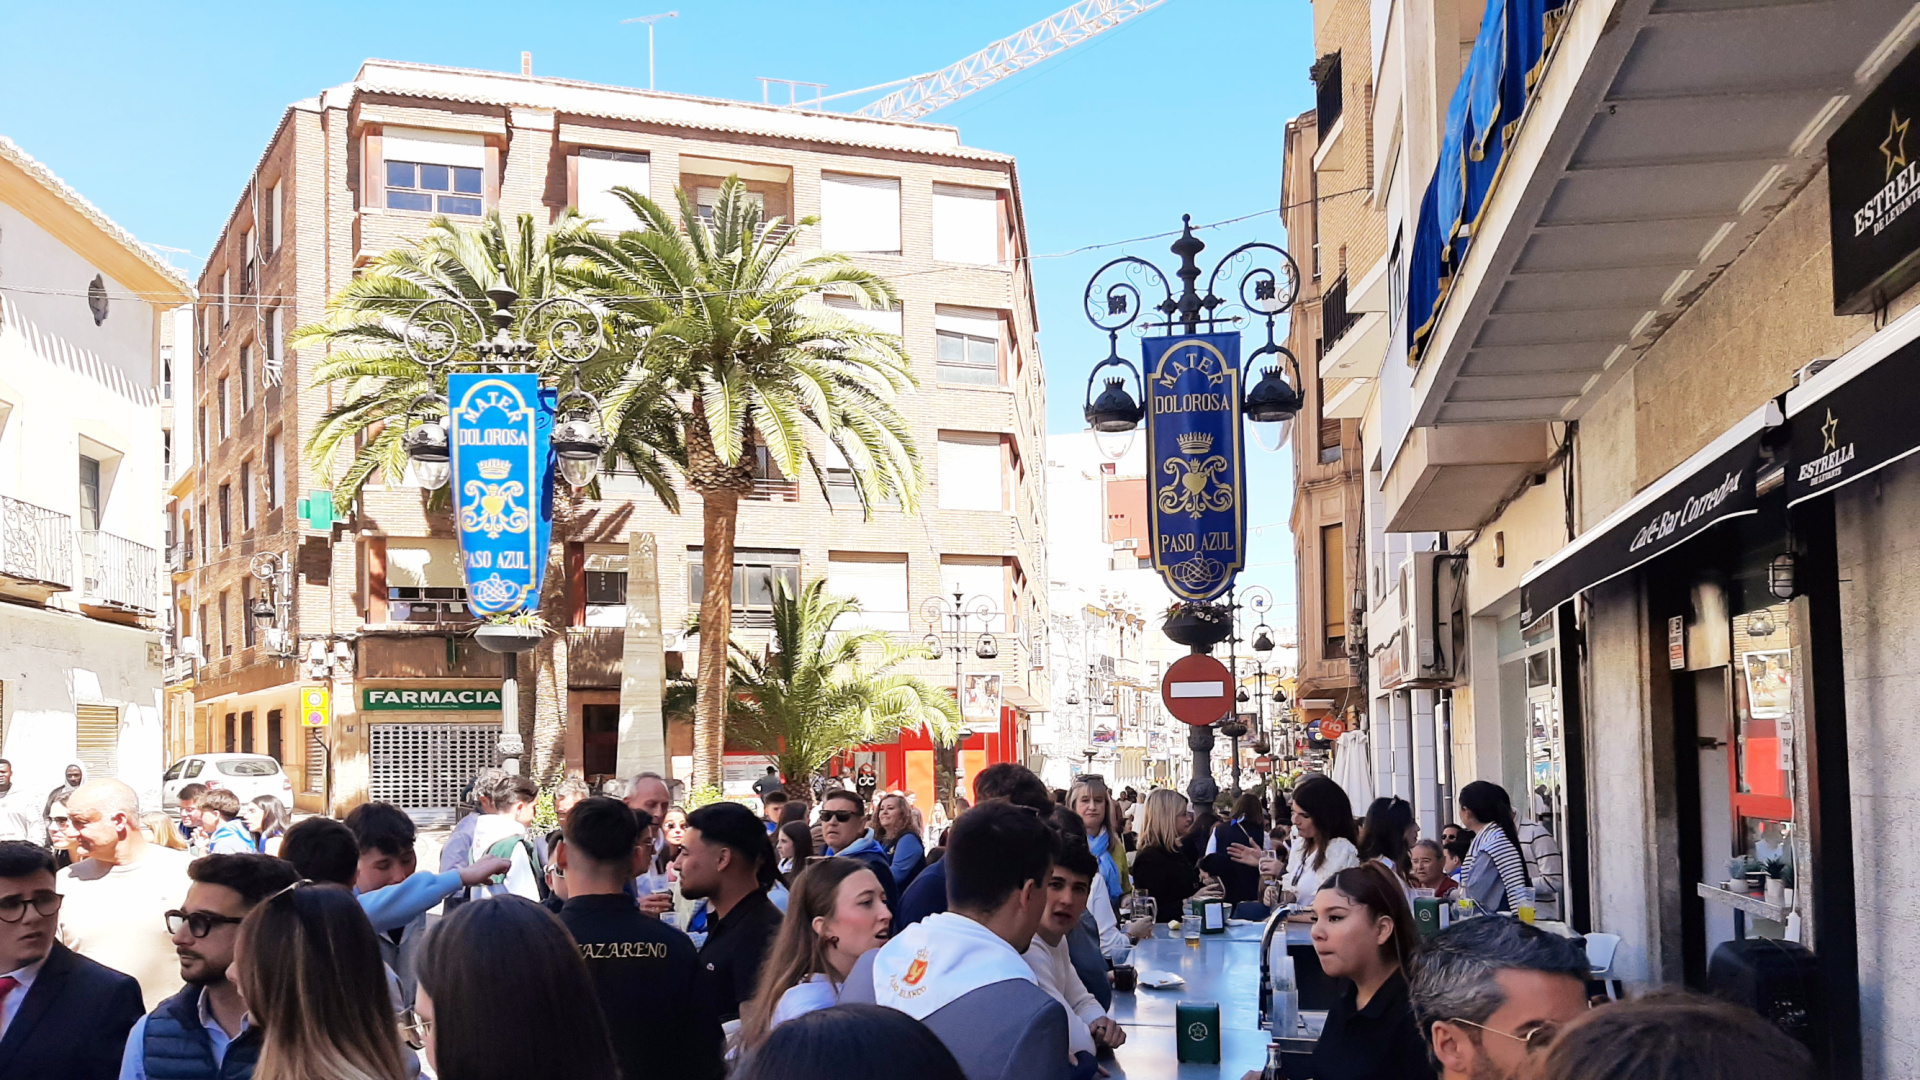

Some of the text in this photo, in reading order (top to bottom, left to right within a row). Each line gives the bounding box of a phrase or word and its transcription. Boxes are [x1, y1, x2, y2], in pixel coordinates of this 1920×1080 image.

[1873, 215, 1886, 236] DE
[1159, 352, 1224, 389] MATER
[463, 392, 523, 424] MATER
[1155, 393, 1230, 415] DOLOROSA
[459, 428, 528, 446] DOLOROSA
[1797, 442, 1855, 482] ESTRELLA
[1629, 508, 1682, 552] Café-Bar
[1161, 531, 1234, 553] PASO AZUL
[464, 550, 529, 569] PASO AZUL
[369, 691, 501, 704] FARMACIA
[578, 942, 667, 958] AZARENO
